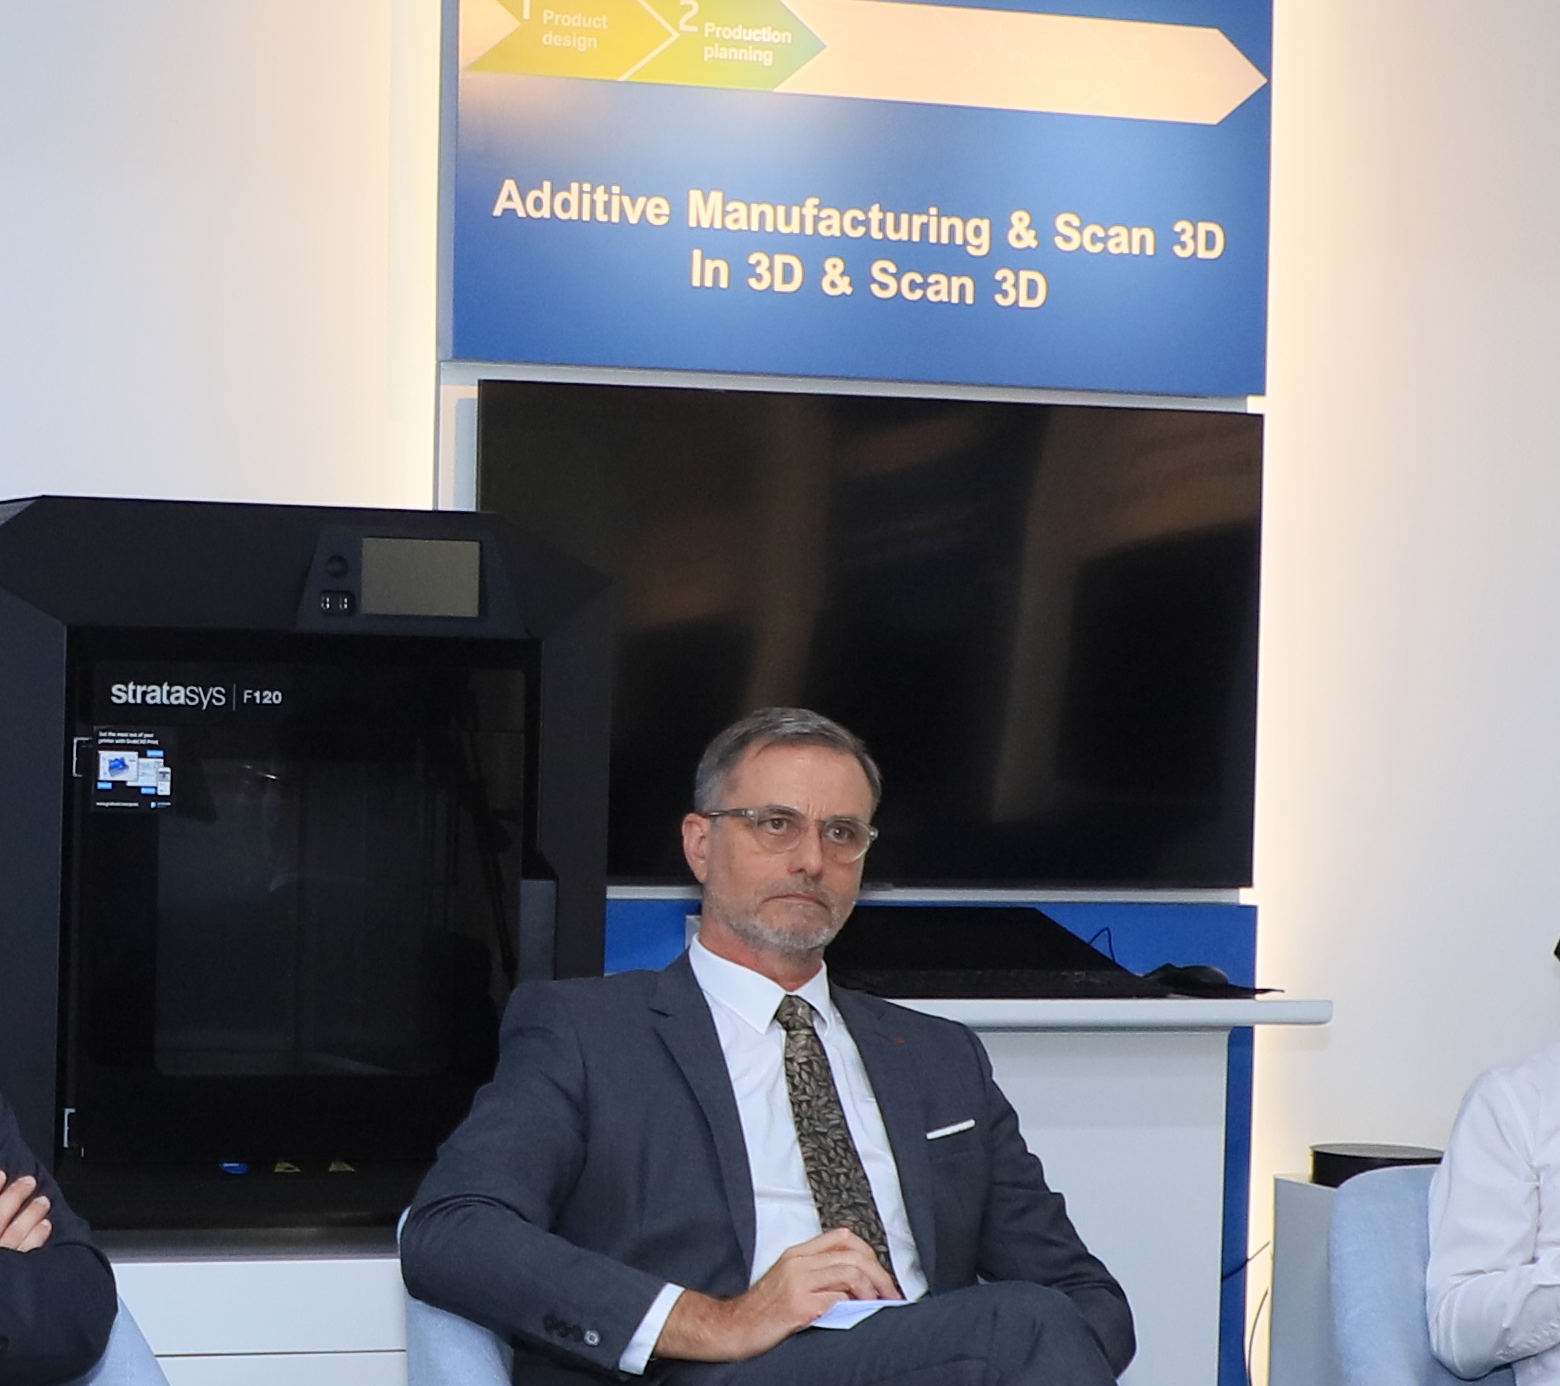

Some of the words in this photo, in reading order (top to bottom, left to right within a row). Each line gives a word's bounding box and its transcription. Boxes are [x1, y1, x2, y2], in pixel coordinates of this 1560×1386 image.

[542, 9, 609, 31] Product
[541, 31, 598, 53] design
[704, 21, 793, 46] Production
[703, 44, 774, 67] planning
[492, 178, 671, 226] Additive
[689, 190, 992, 256] Manufacturing
[1007, 209, 1039, 249] &
[1053, 212, 1157, 256] Scan
[1172, 220, 1226, 260] 3D
[691, 248, 730, 289] In
[747, 251, 804, 293] 3D
[821, 257, 854, 296] &
[869, 259, 975, 305] Scan
[994, 268, 1048, 308] 3D
[110, 681, 227, 710] stratasys
[243, 690, 283, 704] F120
